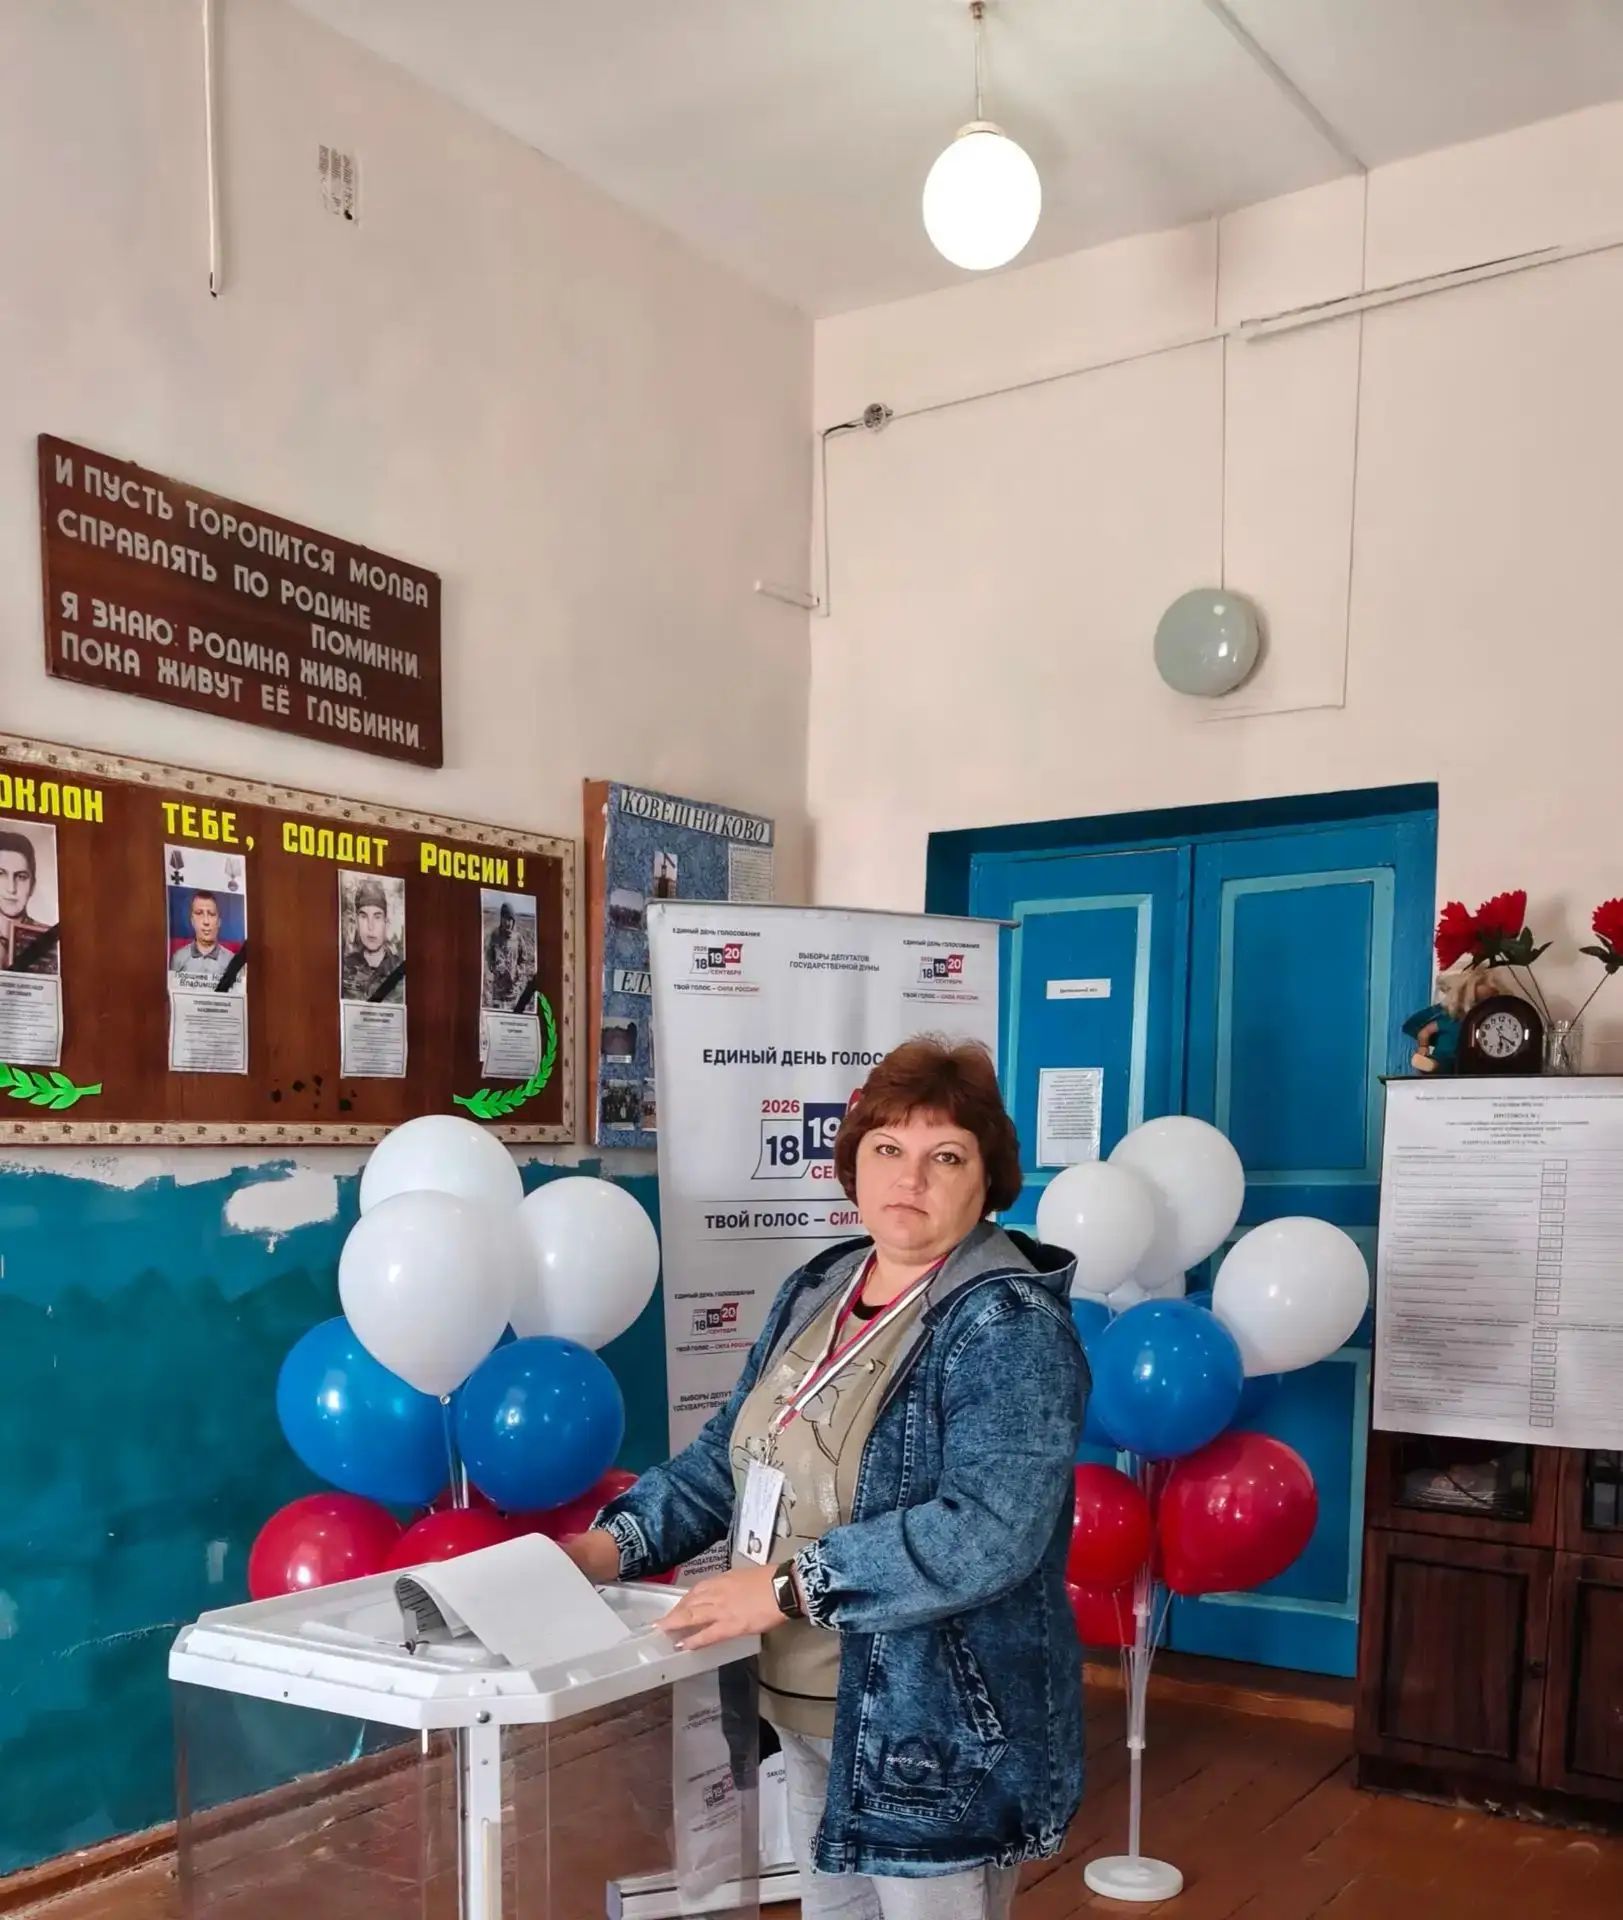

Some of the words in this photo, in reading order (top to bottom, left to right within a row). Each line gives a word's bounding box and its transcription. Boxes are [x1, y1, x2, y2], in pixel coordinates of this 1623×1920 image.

[55, 454, 73, 487] И
[85, 464, 173, 521] ПУСТЬ
[186, 500, 335, 576] ТОРОПИТСЯ
[350, 557, 429, 608] МОЛВА
[57, 508, 217, 583] СПРАВЛЯТЬ
[234, 564, 269, 598] ПО
[281, 578, 371, 630] РОДИНЕ
[61, 591, 78, 621] Я
[92, 598, 178, 647] ЗНАЮ:
[189, 627, 289, 678] РОДИНА
[61, 630, 140, 677] ПОКА
[158, 658, 243, 703] ЖИВУТ
[261, 683, 290, 715] ЕЁ
[623, 790, 766, 842] КОВЕШНИКОВО
[282, 822, 388, 867] СОЛДАТ
[695, 958, 708, 970] 18
[709, 951, 723, 965] 19
[724, 947, 740, 960] 20
[790, 961, 858, 971] ГОСУДАРСТВЕННОЙ
[922, 968, 933, 979] 18
[935, 963, 946, 974] 19
[947, 958, 961, 970] 20
[703, 1046, 777, 1066] ЕДИНЫЙ
[781, 1050, 827, 1067] ДЕНЬ
[832, 1051, 883, 1066] ГОЛОС
[762, 1100, 800, 1113] 2026
[766, 1135, 799, 1166] 18
[808, 1116, 840, 1148] 19
[705, 1210, 750, 1229] ТВОЙ
[754, 1212, 809, 1228] ГОЛОС
[829, 1211, 863, 1226] СИЛ
[695, 1319, 706, 1331] 18
[708, 1313, 720, 1324] 19
[721, 1307, 736, 1318] 20
[710, 1390, 732, 1400] ДЕПУТ
